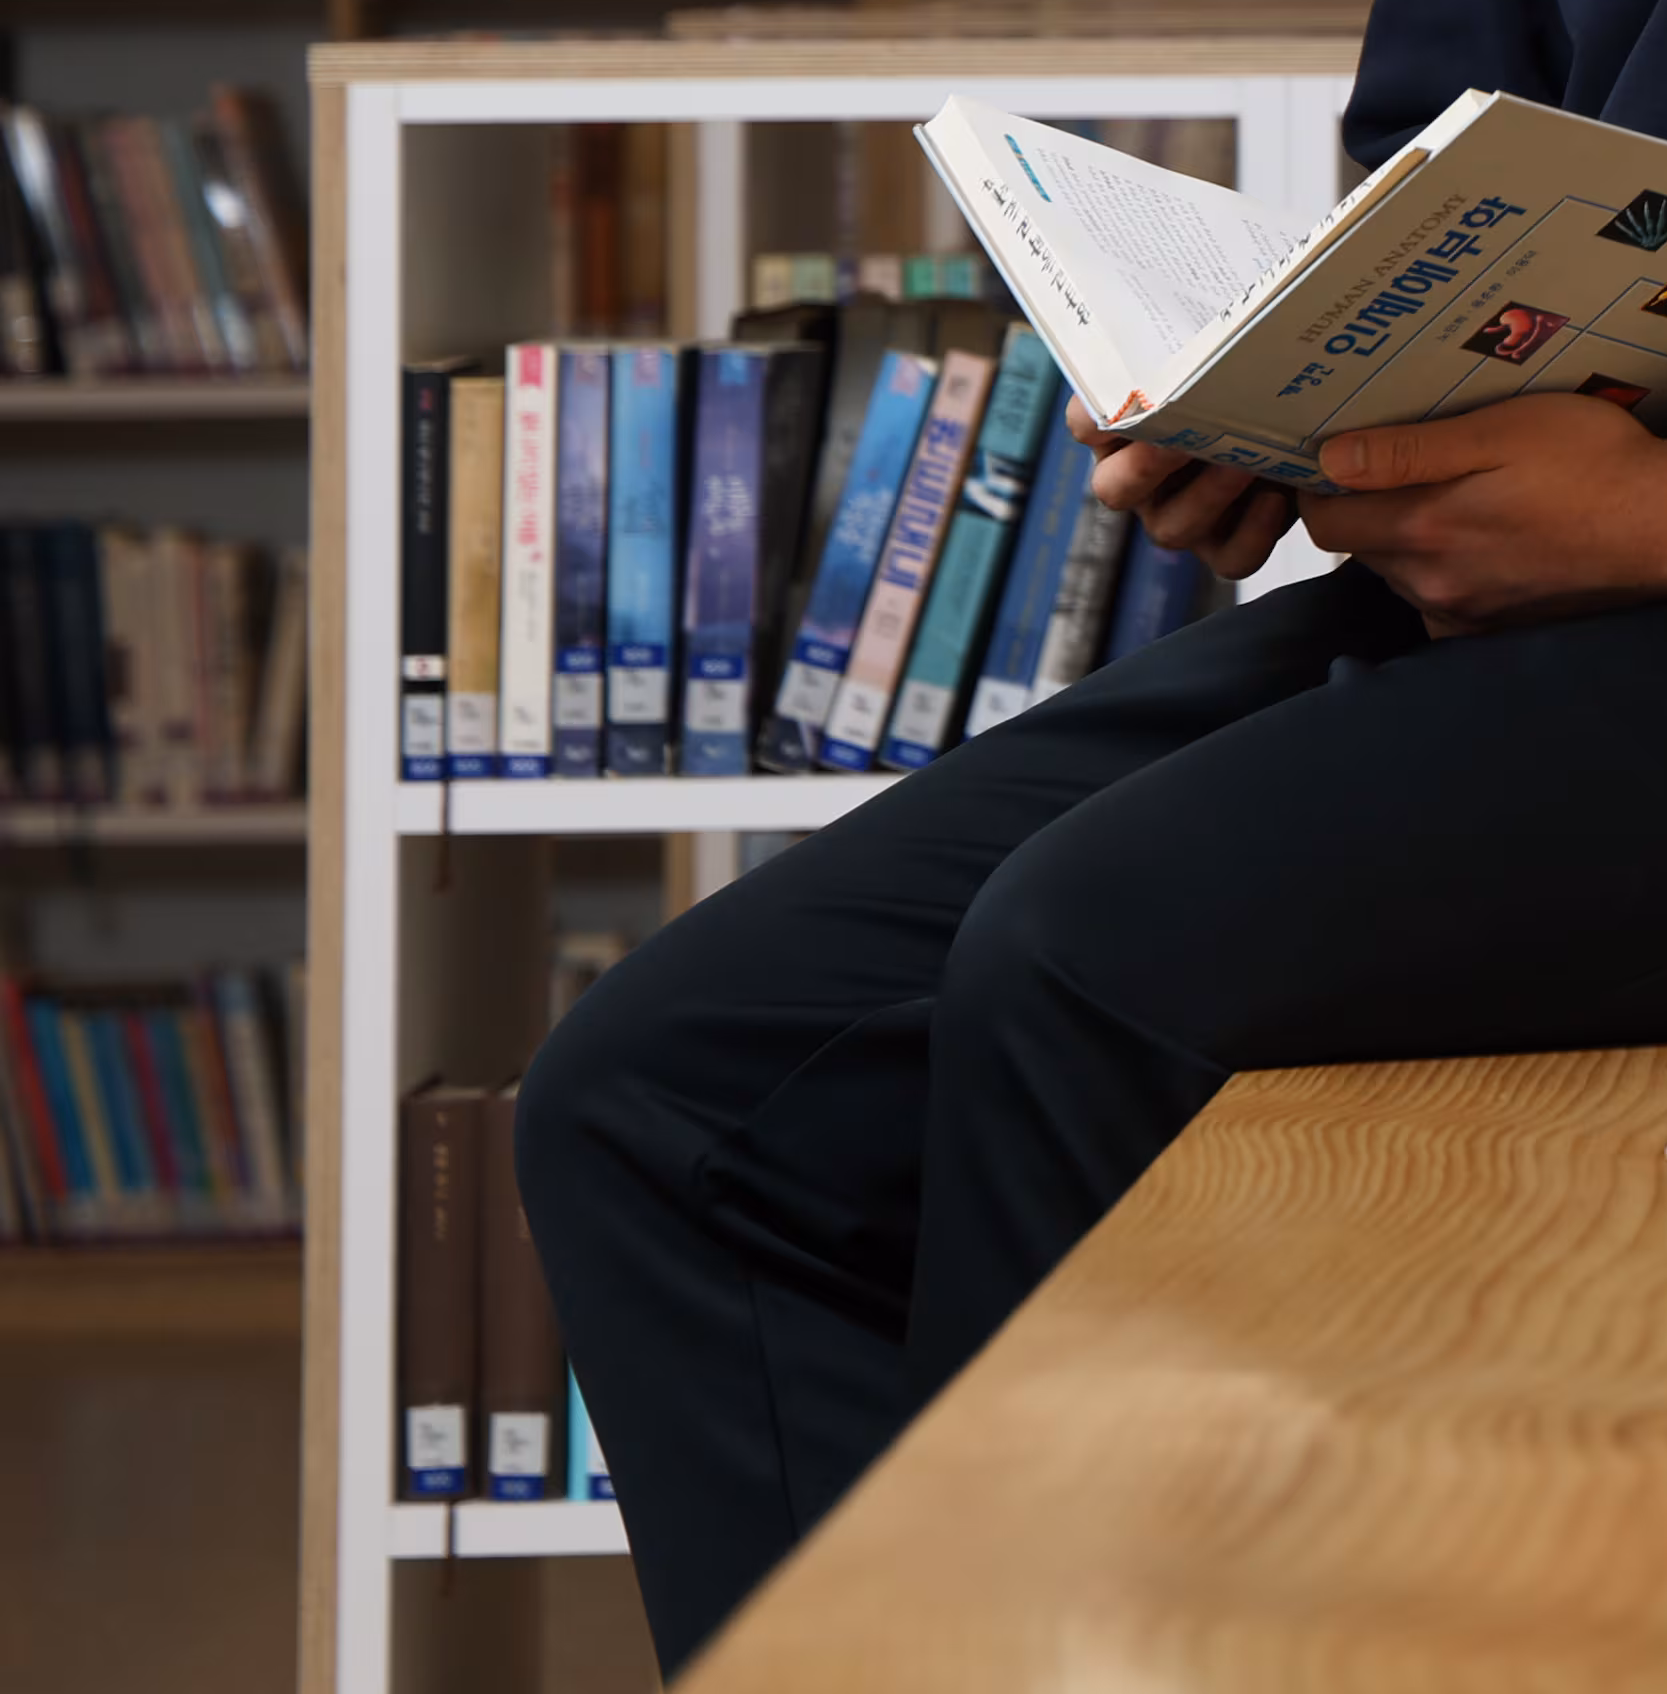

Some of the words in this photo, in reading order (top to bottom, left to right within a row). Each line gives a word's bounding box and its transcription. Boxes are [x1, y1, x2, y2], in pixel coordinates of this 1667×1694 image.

[1297, 278, 1376, 344] HUMAN
[1374, 193, 1468, 277] ANATOMY
[1324, 196, 1527, 356] 인체해부학
